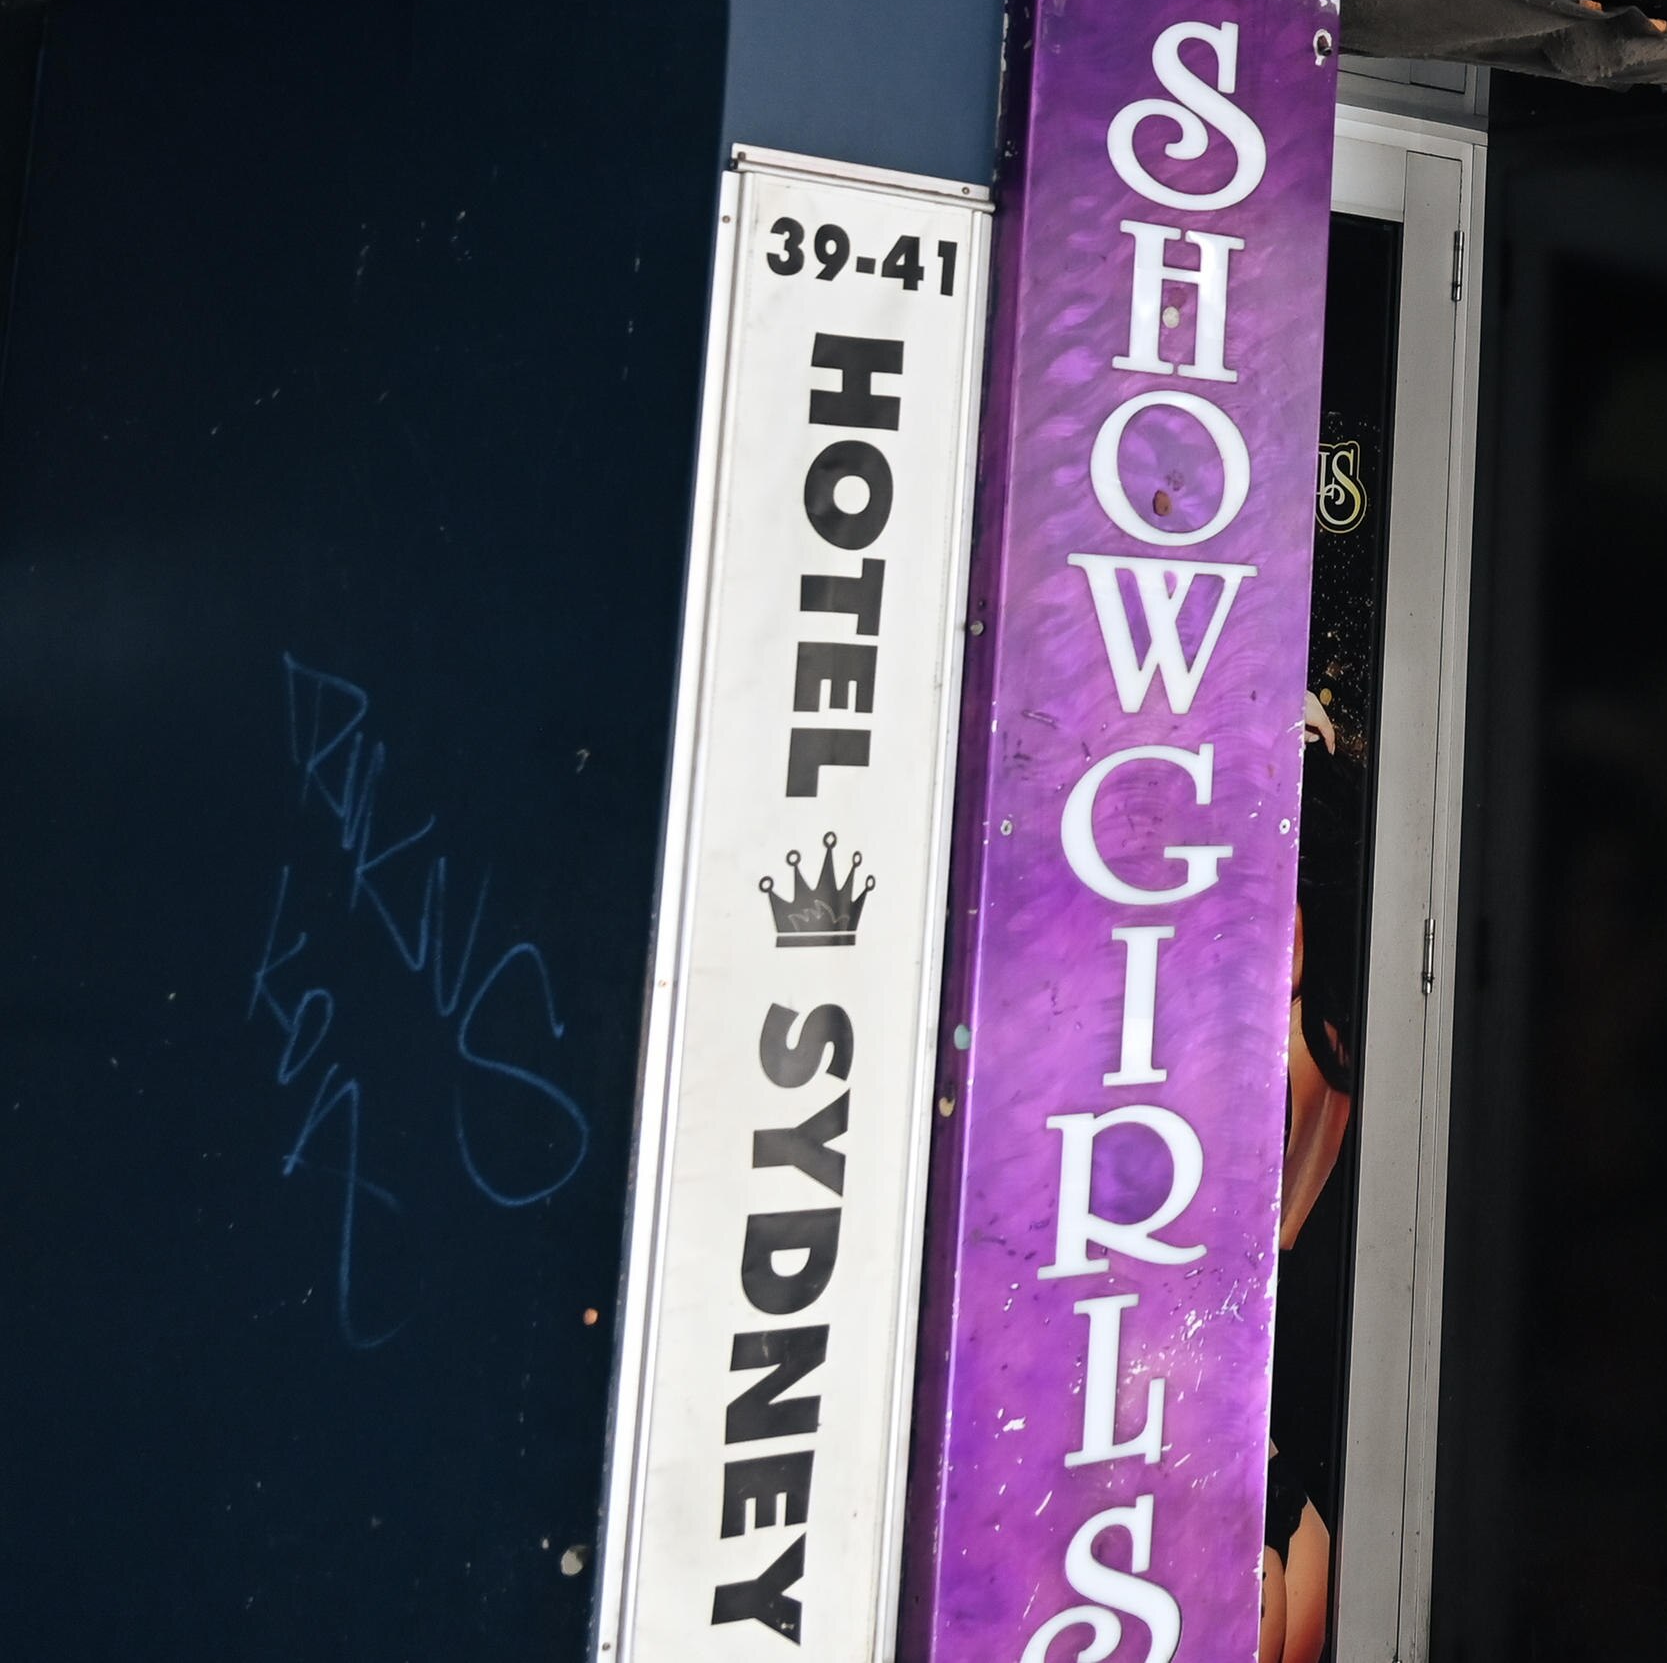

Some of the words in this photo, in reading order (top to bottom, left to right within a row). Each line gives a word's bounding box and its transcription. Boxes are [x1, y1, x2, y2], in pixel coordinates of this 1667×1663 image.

[764, 216, 960, 298] 39-41
[784, 332, 905, 799] HOTEL
[1020, 17, 1268, 1663] SHOWGIRLS
[710, 1002, 856, 1647] SYDNEY
